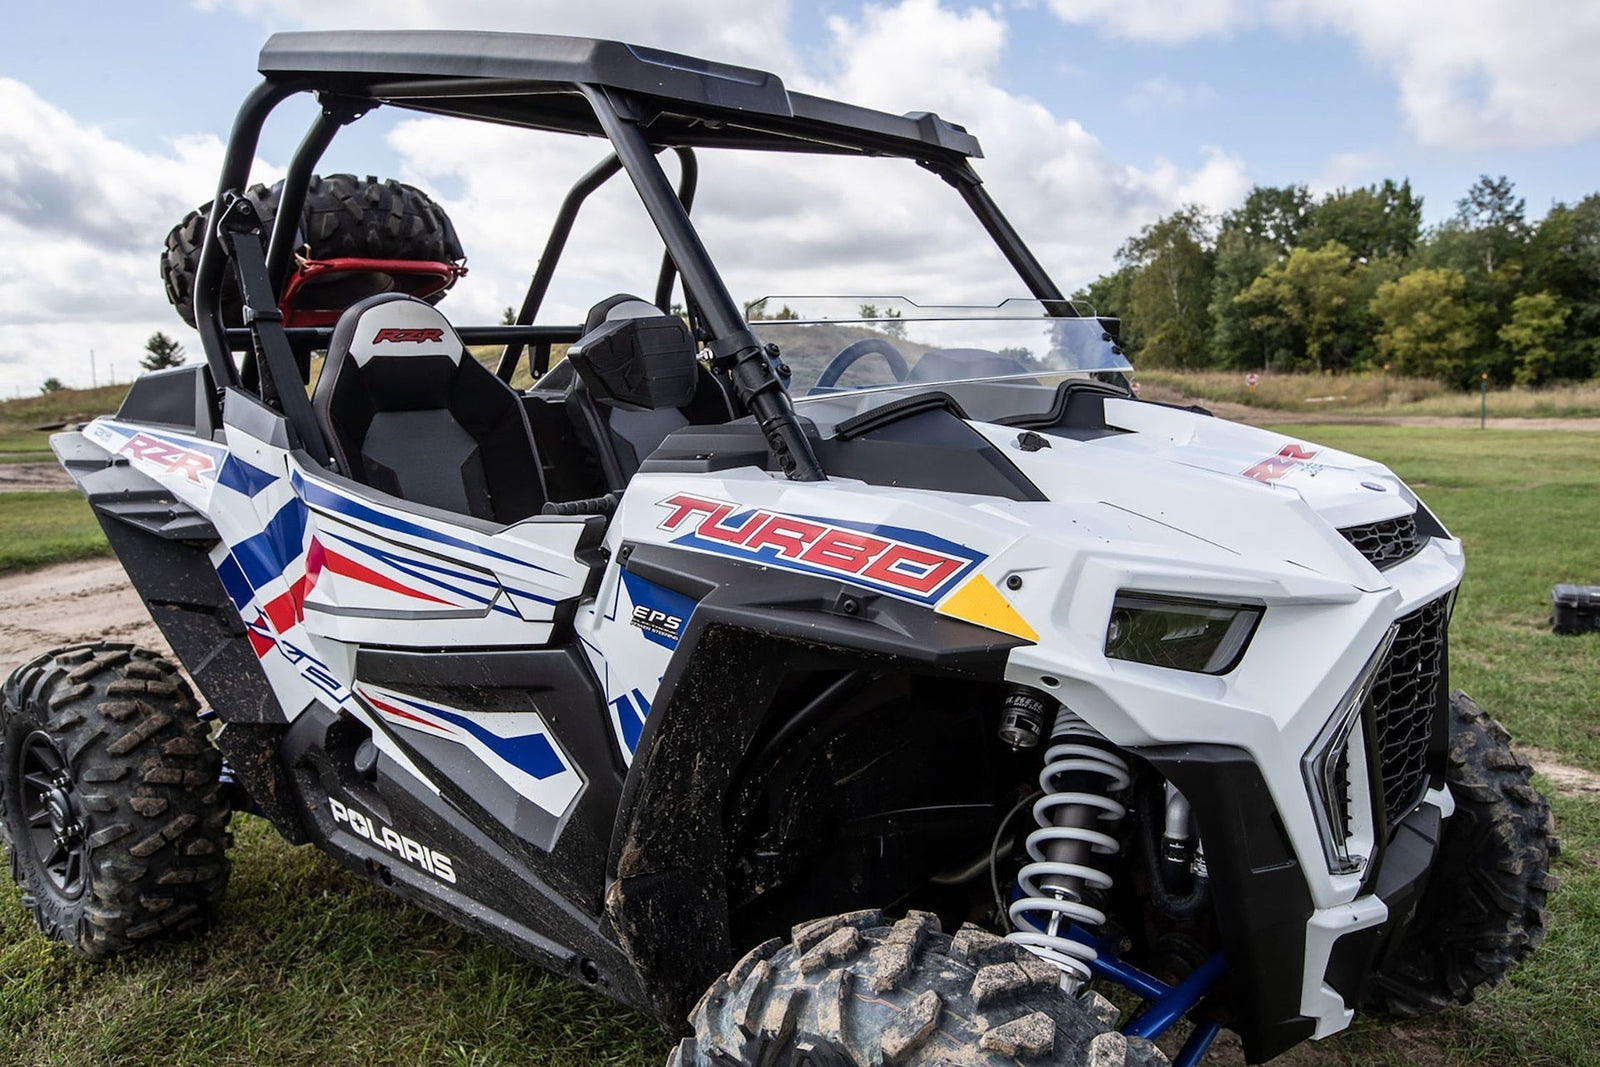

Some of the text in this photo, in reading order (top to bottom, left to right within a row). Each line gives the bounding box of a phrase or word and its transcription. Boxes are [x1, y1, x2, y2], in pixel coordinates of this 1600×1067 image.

[373, 328, 445, 345] RZR
[118, 433, 215, 486] RZR
[658, 492, 970, 597] TURBO
[632, 604, 683, 631] EPS
[328, 796, 457, 884] POLARIS
